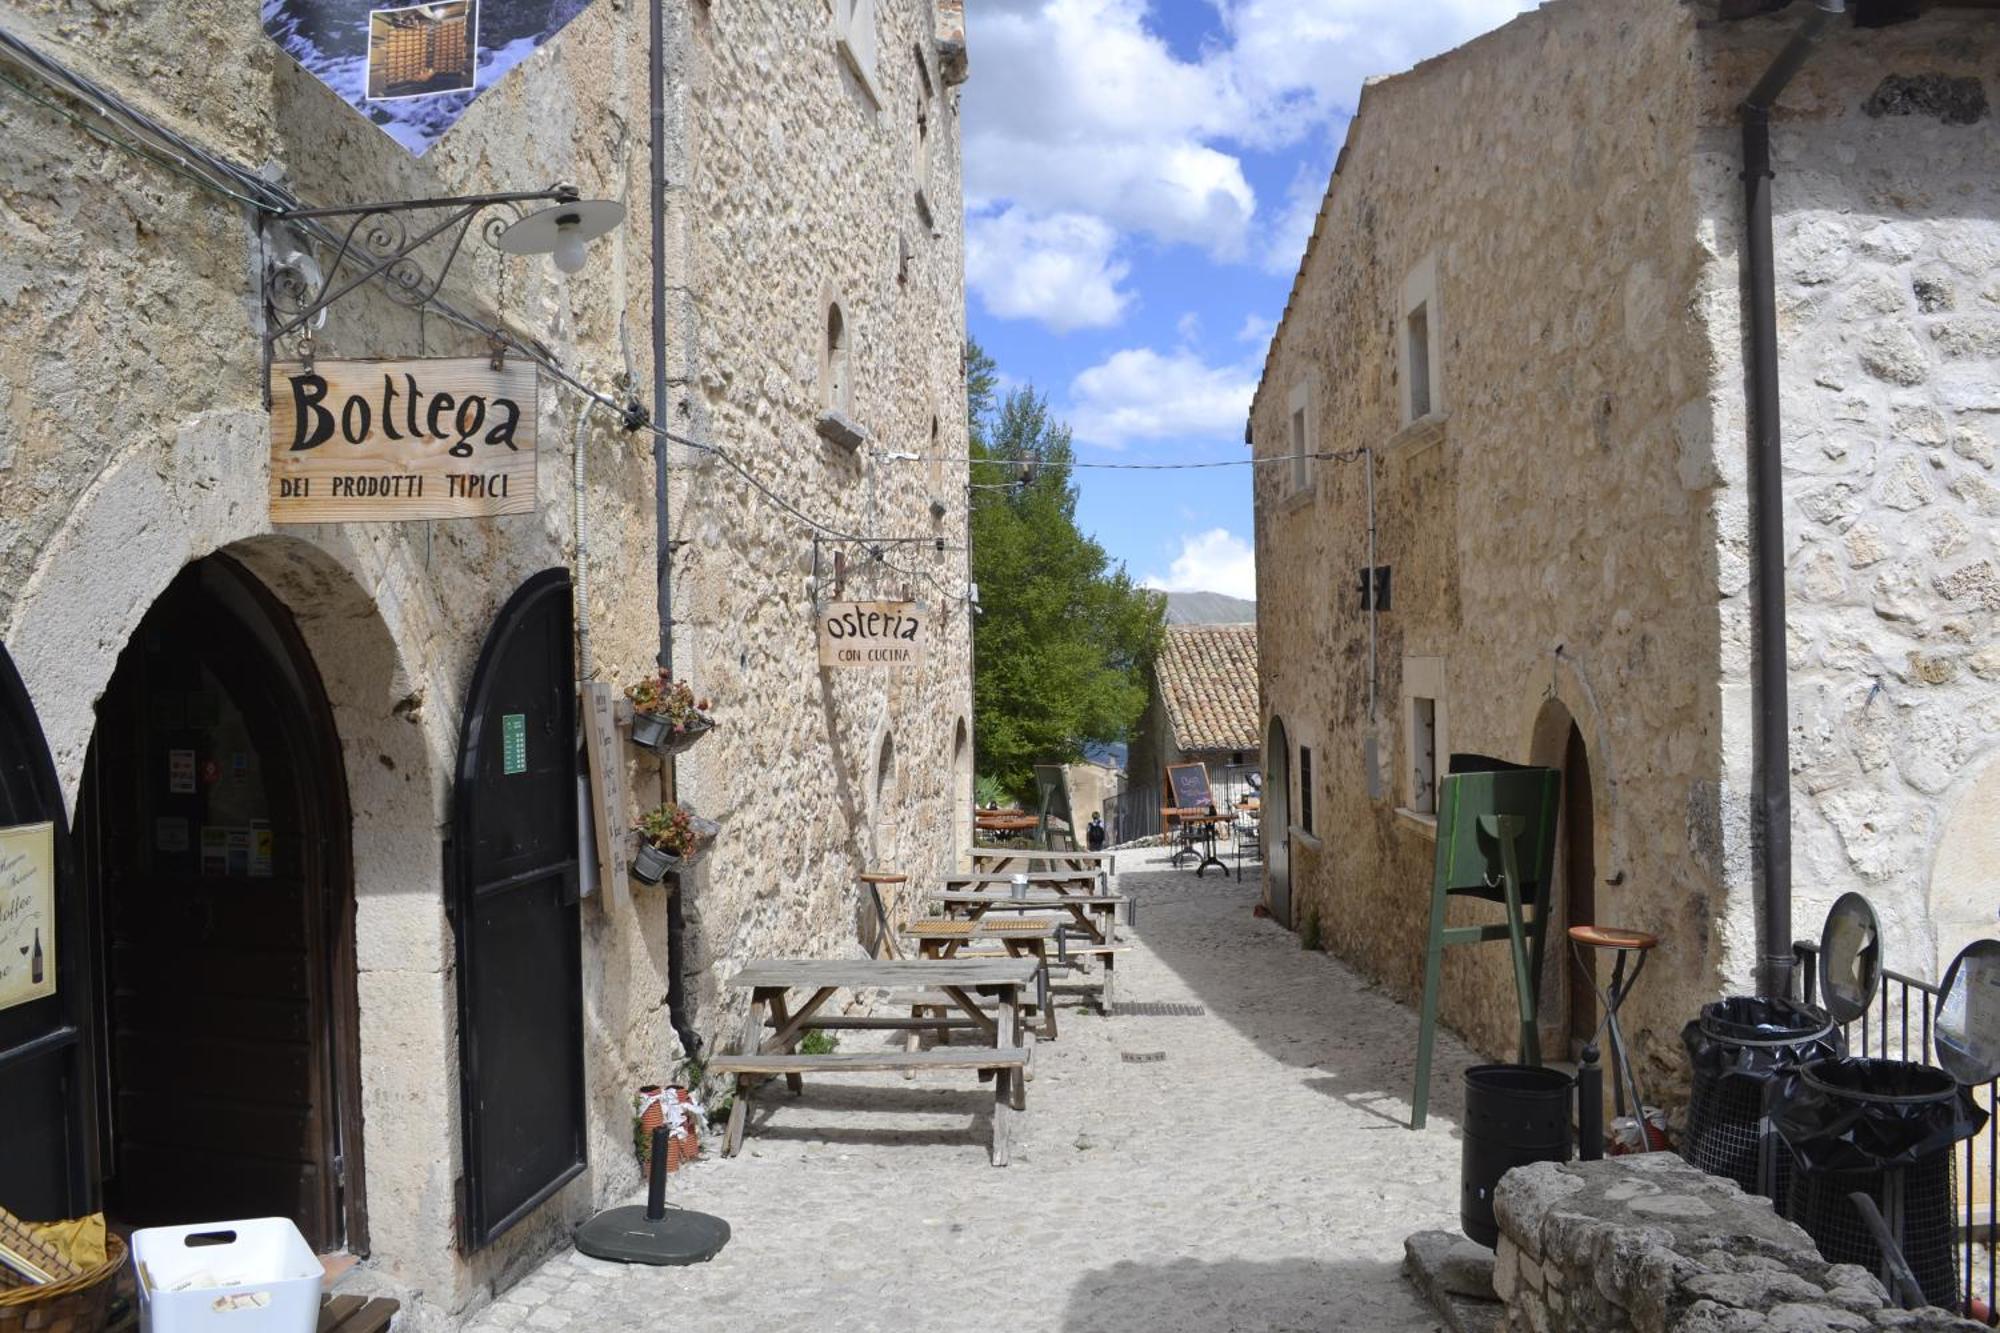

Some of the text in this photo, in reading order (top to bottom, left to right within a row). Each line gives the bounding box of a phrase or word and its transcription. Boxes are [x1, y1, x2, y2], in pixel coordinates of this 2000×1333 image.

[288, 373, 520, 458] Bottega
[280, 473, 508, 498] DEI PRODOTTI TIPICI
[827, 605, 919, 641] osteria
[838, 649, 911, 662] CON CUCINA
